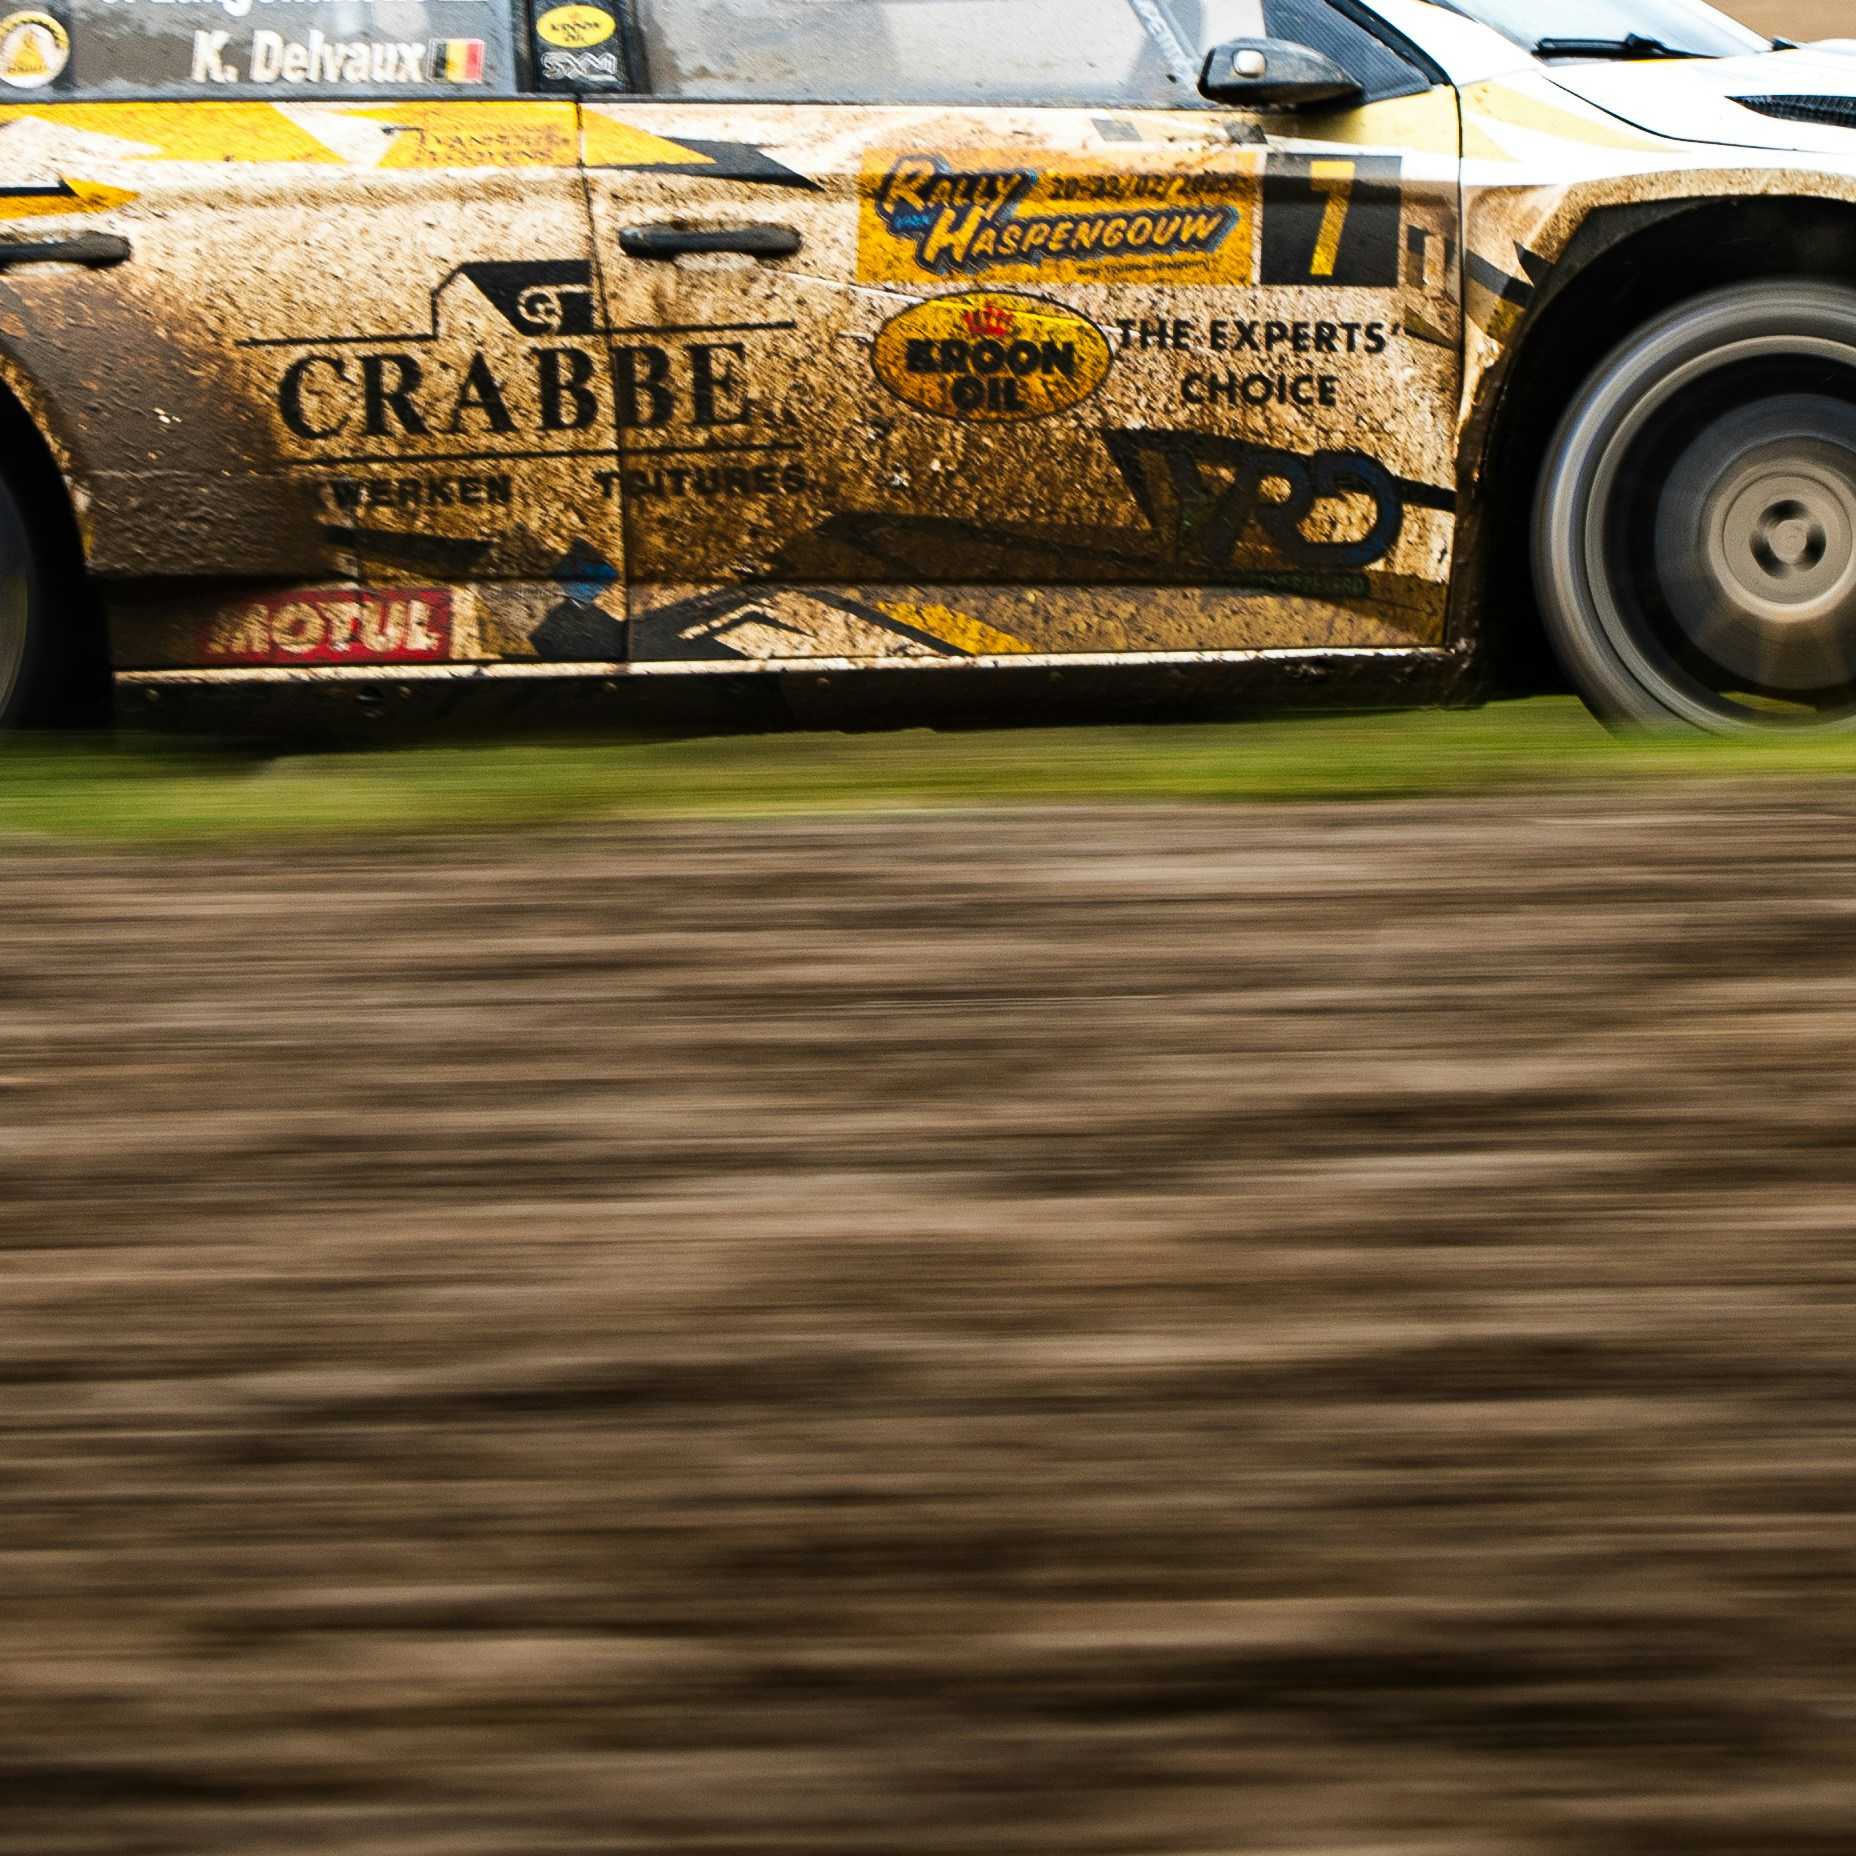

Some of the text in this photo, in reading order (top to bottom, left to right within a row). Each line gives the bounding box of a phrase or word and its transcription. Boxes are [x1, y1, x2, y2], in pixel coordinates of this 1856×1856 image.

[190, 29, 428, 85] K. Delvaux
[1309, 160, 1356, 276] 7
[906, 338, 1076, 375] KROON
[1116, 317, 1189, 352] THE
[277, 343, 751, 440] CRABBE
[951, 376, 1028, 411] OIL
[1180, 371, 1340, 406] CHOICE
[206, 599, 443, 654] MOTUL
